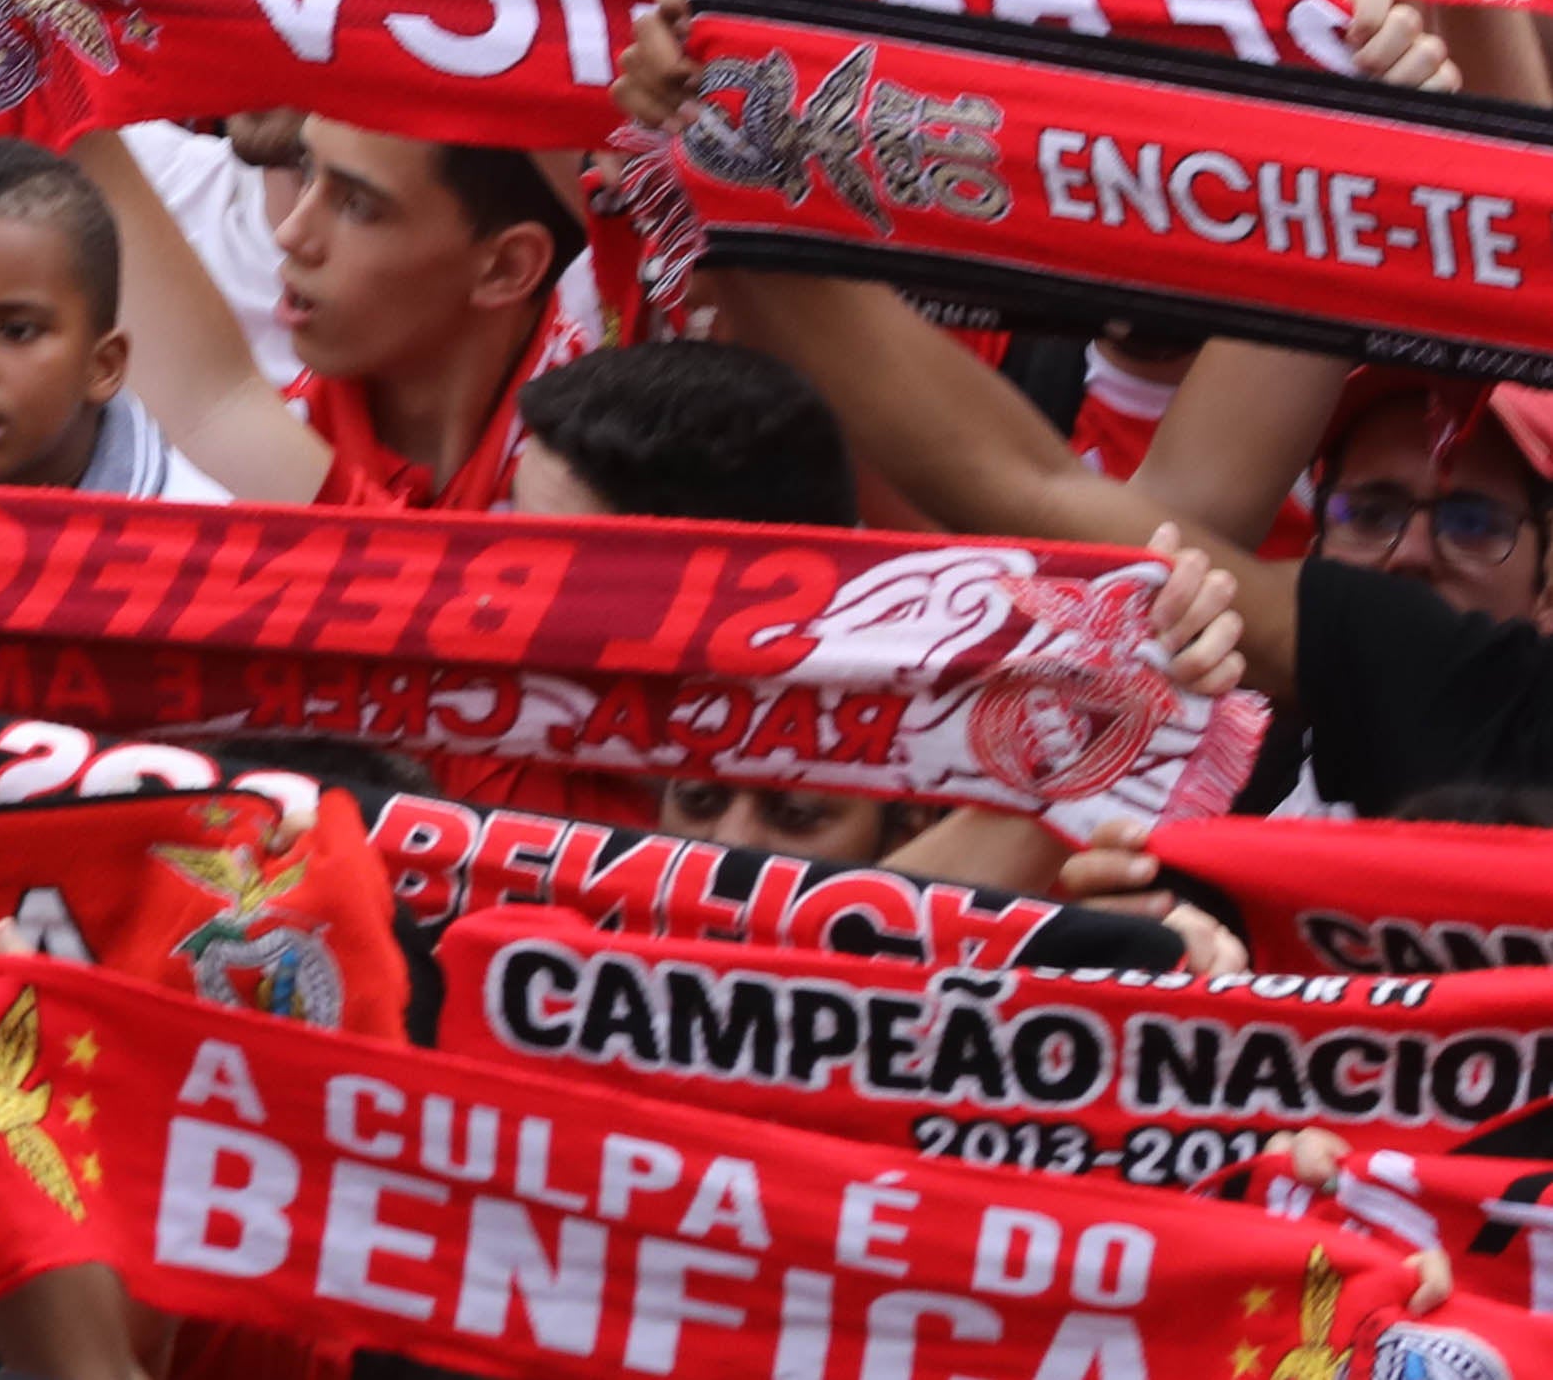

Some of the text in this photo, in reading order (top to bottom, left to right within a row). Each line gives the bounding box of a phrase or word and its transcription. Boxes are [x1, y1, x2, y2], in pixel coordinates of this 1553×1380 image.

[1036, 125, 1525, 292] ENCHE-TE
[487, 941, 1115, 1114] CAMPEÃO
[176, 1038, 1158, 1310] A CULPA É DO
